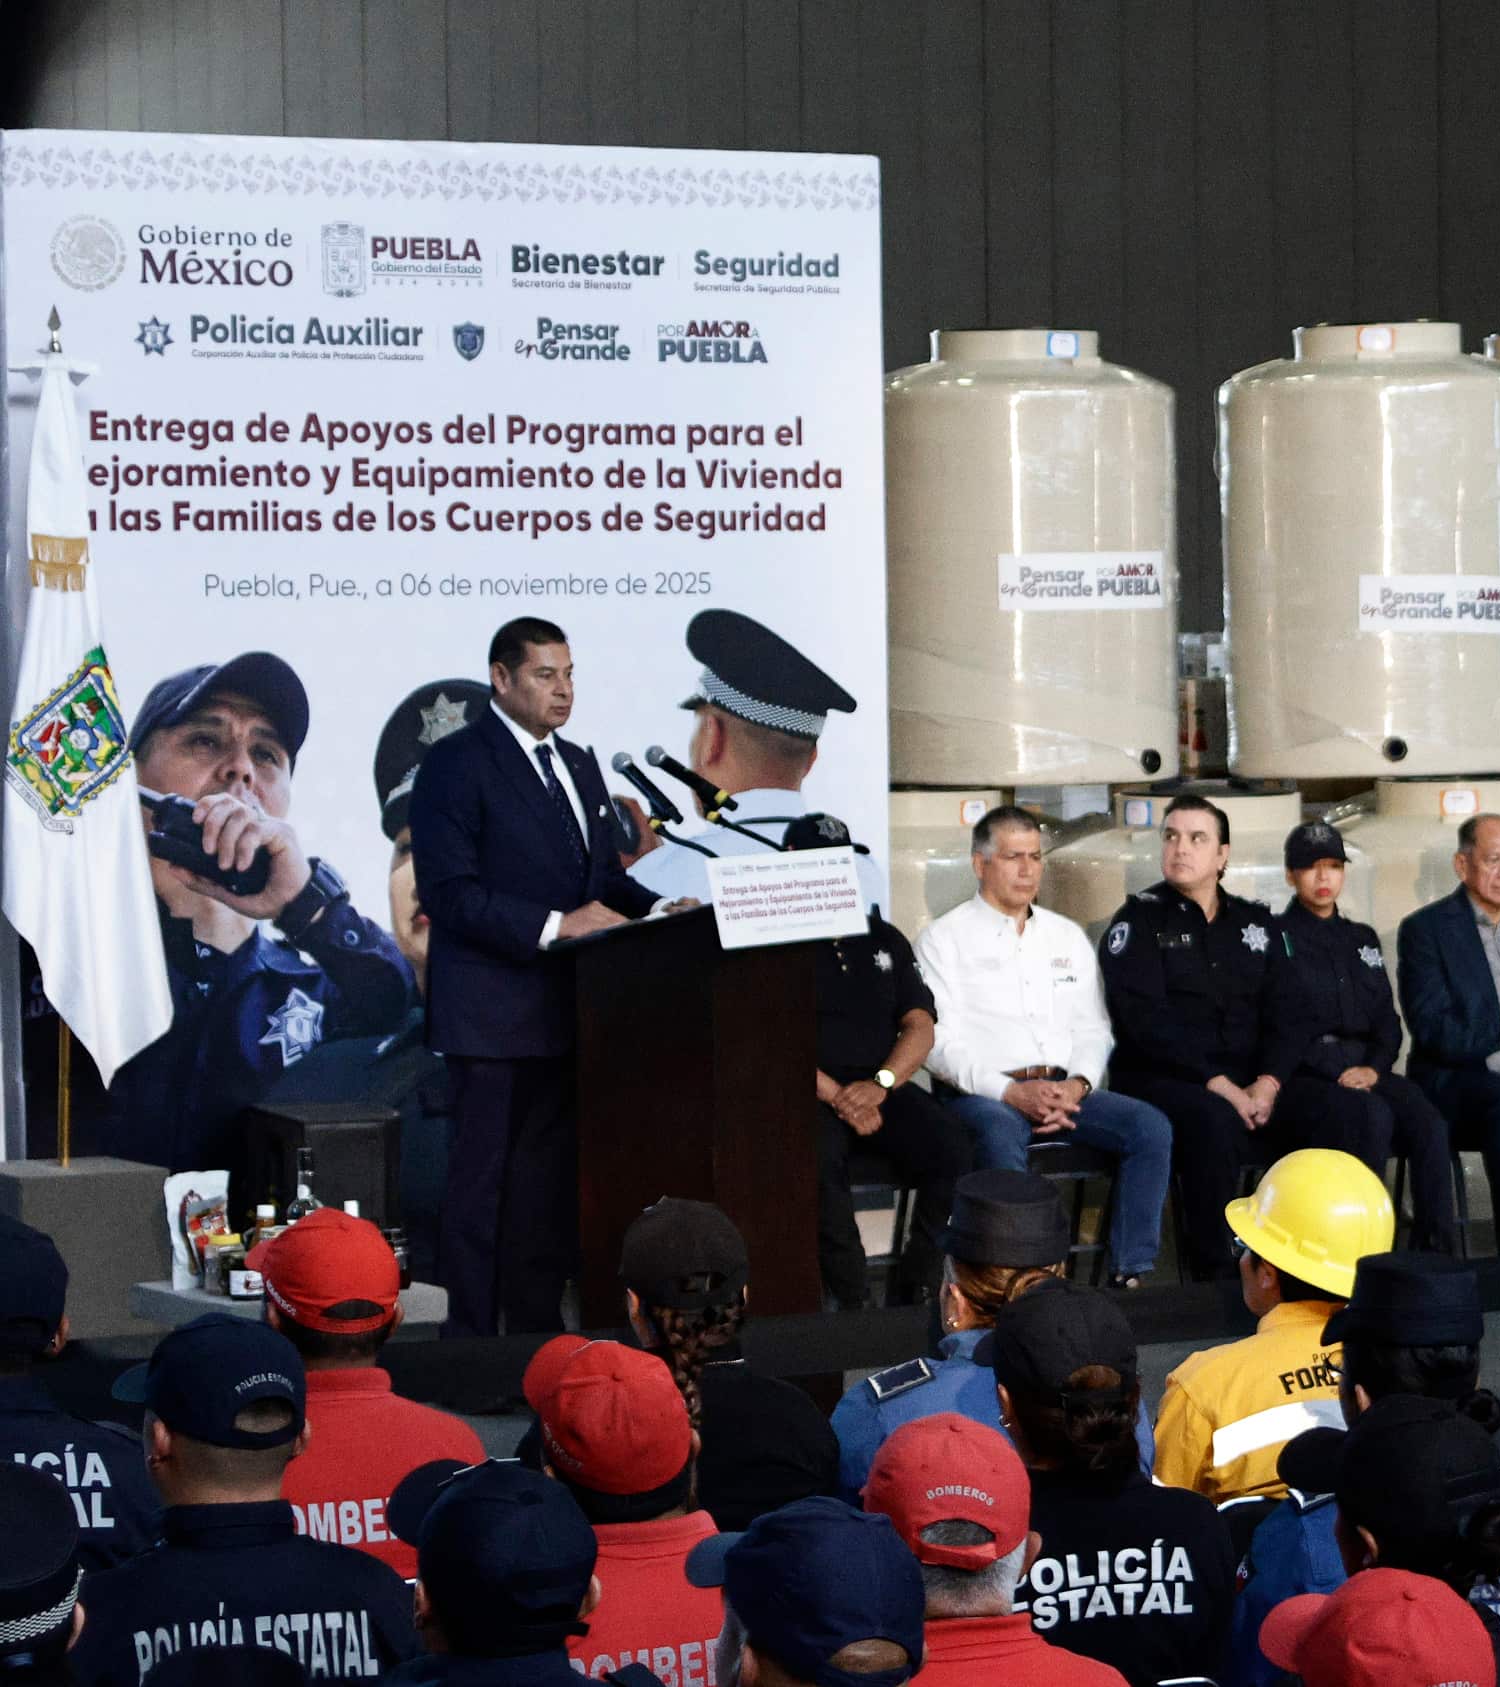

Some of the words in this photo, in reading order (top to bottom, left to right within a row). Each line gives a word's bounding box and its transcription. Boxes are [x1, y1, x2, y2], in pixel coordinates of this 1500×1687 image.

[139, 225, 258, 247] Gobierno
[265, 228, 293, 247] de
[371, 236, 482, 261] PUEBLA
[140, 248, 293, 287] México
[371, 261, 423, 273] Gobierno
[425, 263, 442, 273] del
[444, 263, 483, 274] Estado
[511, 243, 665, 276] Bienestar
[694, 249, 840, 283] Seguridad
[568, 280, 581, 289] de
[584, 279, 632, 290] Bienestar
[743, 283, 755, 293] de
[757, 284, 805, 295] Seguridad
[190, 314, 295, 344] Policía
[303, 316, 424, 347] Auxiliar
[536, 316, 620, 341] Pensar
[246, 350, 277, 360] Auxiliar
[278, 351, 290, 360] de
[320, 351, 331, 360] de
[657, 339, 768, 364] PUEBLA
[89, 410, 234, 451] Entrega
[245, 412, 290, 443] de
[300, 412, 433, 451] Apoyos
[443, 413, 496, 445] del
[506, 414, 676, 453] Programa
[687, 422, 765, 453] para
[774, 415, 803, 446] el
[84, 455, 311, 495] ejoramiento
[321, 464, 341, 495] y
[351, 456, 594, 495] Equipamiento
[604, 459, 646, 489] de
[656, 458, 686, 489] la
[695, 459, 842, 489] Vivienda
[109, 500, 161, 532] las
[173, 501, 322, 532] Familias
[332, 501, 377, 532] de
[388, 501, 436, 532] los
[446, 501, 592, 540] Cuerpos
[601, 502, 643, 532] de
[654, 501, 826, 540] Seguridad
[204, 573, 300, 600] Puebla,
[309, 574, 367, 600] Pue.,
[375, 581, 392, 597] a
[400, 574, 432, 597] 06
[439, 573, 472, 597] de
[480, 572, 608, 597] noviembre
[615, 572, 647, 595] de
[655, 571, 712, 595] 2025
[1019, 566, 1085, 583] Pensar
[1097, 578, 1161, 597] PUEBLA
[1380, 587, 1445, 604] Pensar
[926, 1484, 995, 1507] BOMBEROS
[1015, 1538, 1194, 1595] OLICÍA
[1011, 1582, 1193, 1630] STATAL
[254, 1609, 379, 1677] ESTATAL
